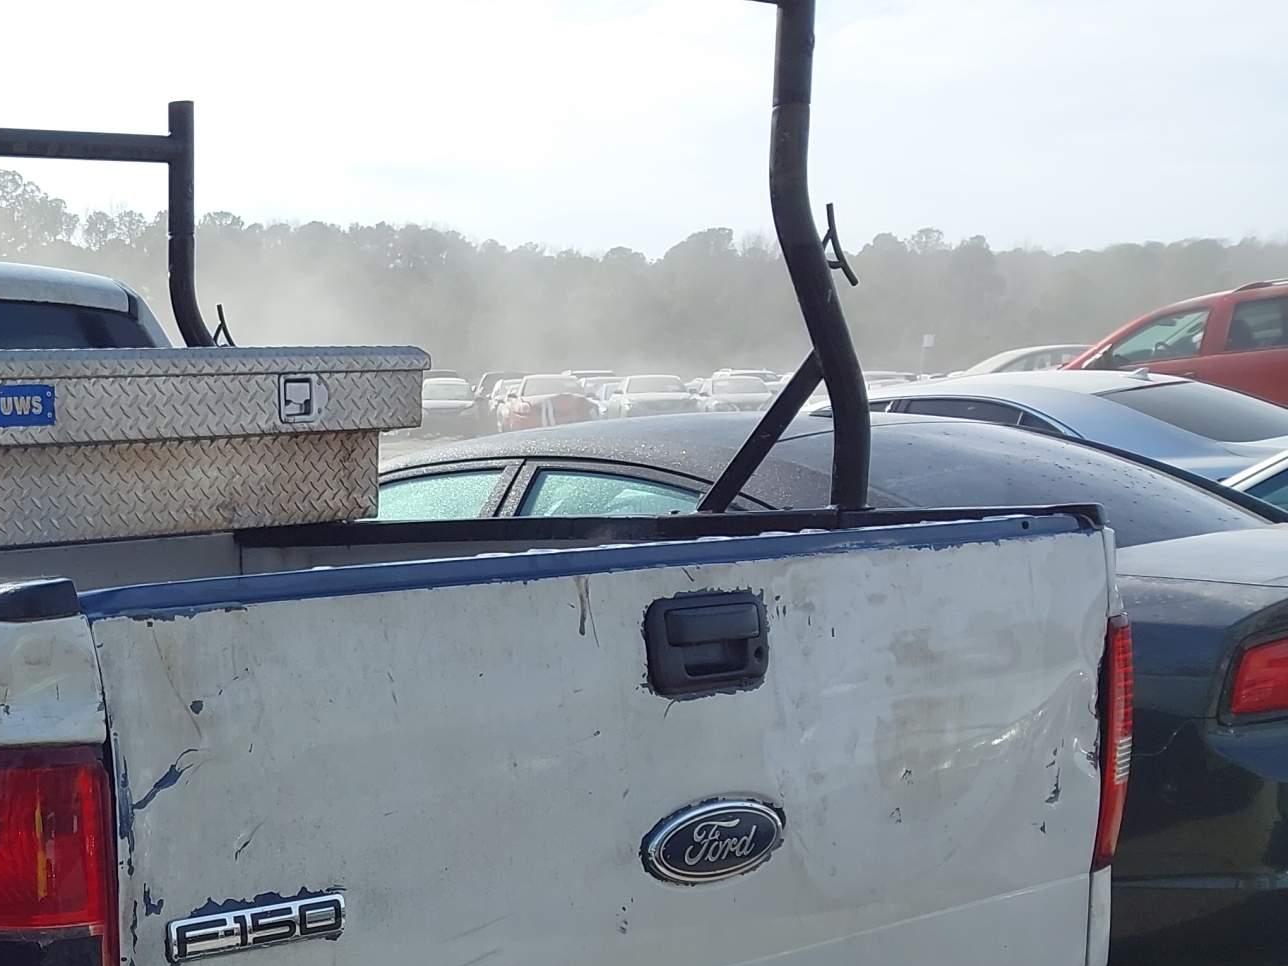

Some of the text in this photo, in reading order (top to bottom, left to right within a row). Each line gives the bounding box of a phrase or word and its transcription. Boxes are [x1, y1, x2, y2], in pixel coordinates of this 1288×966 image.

[0, 395, 44, 416] UWS
[684, 818, 758, 866] Ford
[175, 898, 343, 959] F-150
